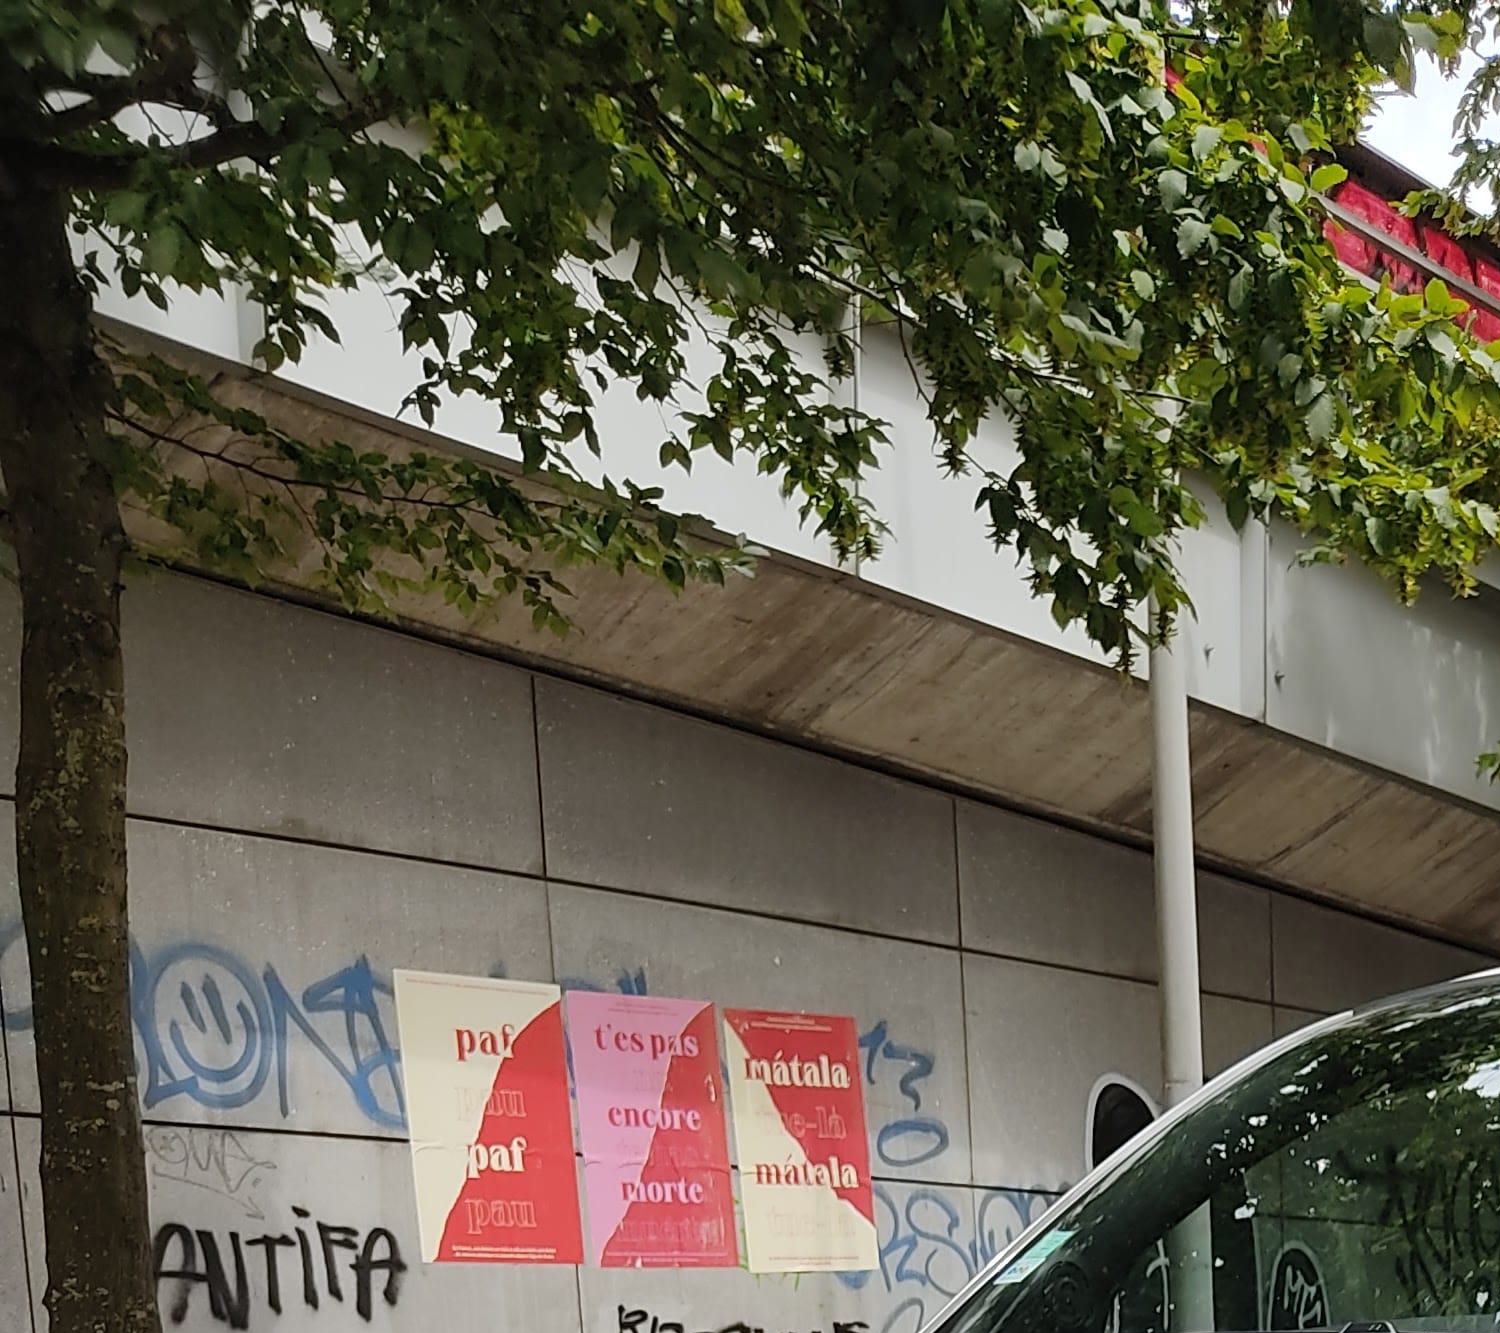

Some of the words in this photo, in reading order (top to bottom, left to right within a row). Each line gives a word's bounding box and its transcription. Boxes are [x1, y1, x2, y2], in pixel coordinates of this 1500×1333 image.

[455, 1023, 515, 1062] paf
[595, 1022, 644, 1053] t'es
[650, 1030, 700, 1061] pas
[745, 1049, 851, 1090] mátala
[608, 1104, 702, 1132] encore
[466, 1136, 528, 1180] paf
[755, 1153, 860, 1189] mátala
[621, 1178, 704, 1204] morte
[465, 1197, 538, 1236] pau
